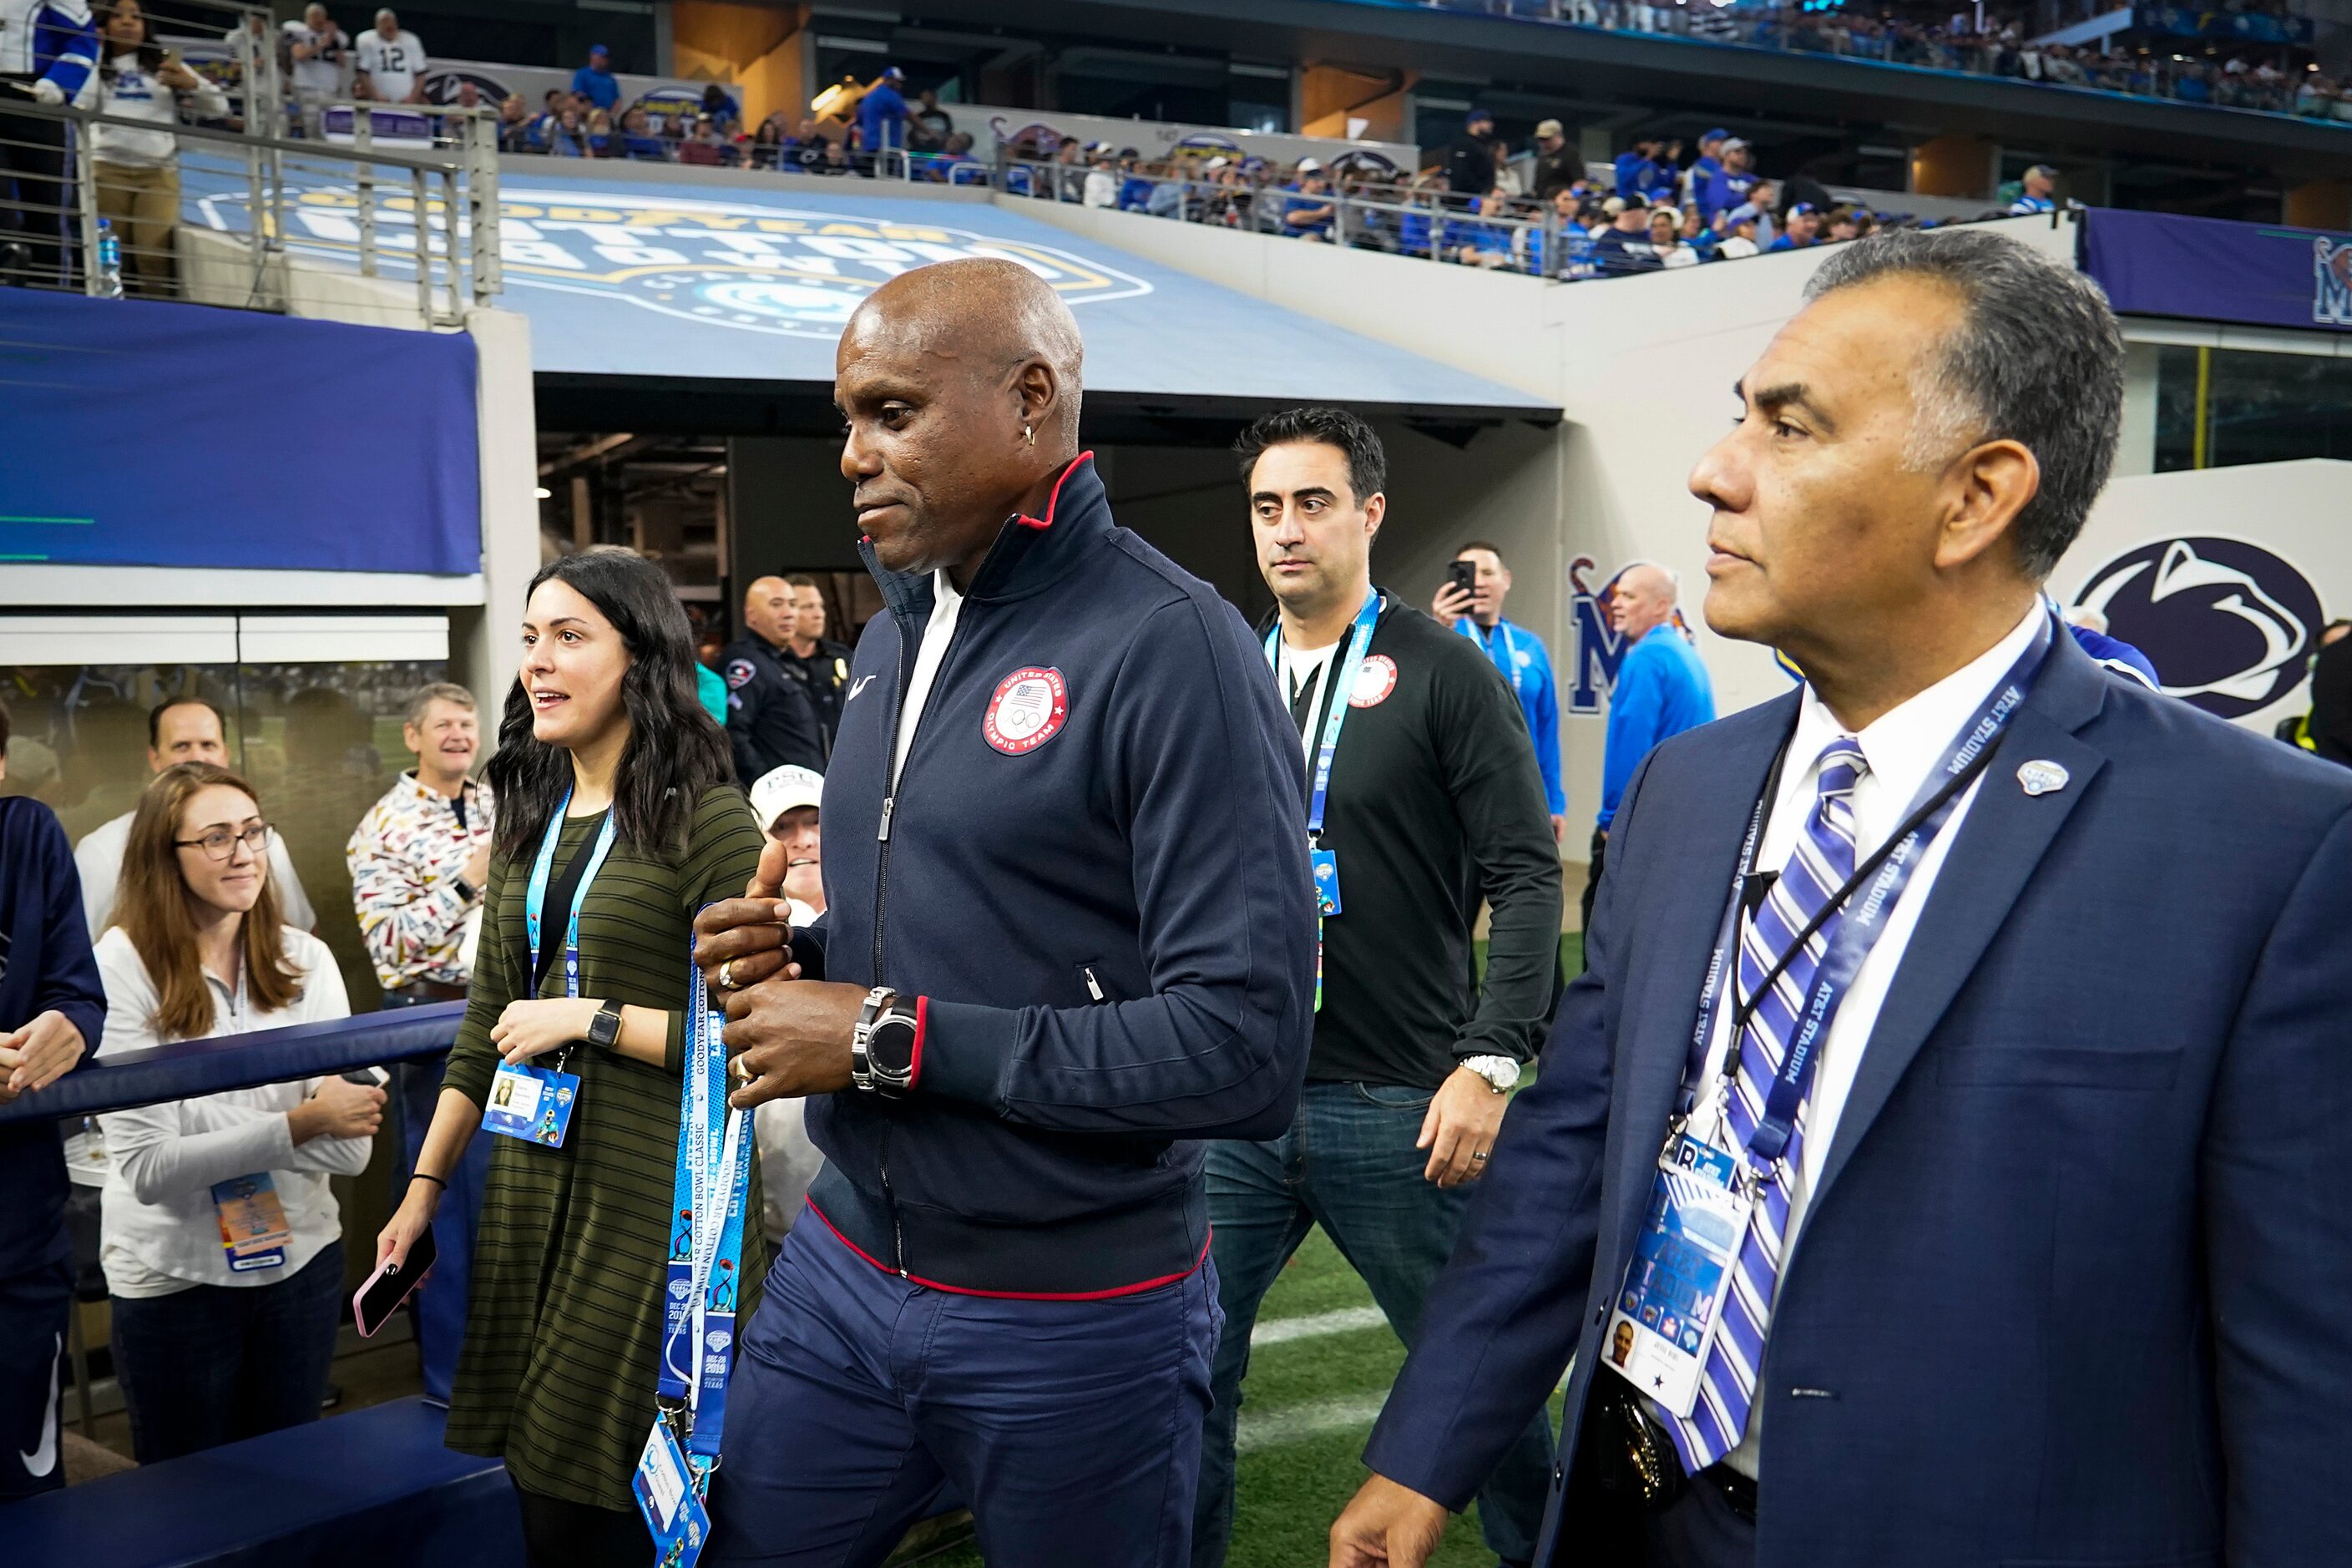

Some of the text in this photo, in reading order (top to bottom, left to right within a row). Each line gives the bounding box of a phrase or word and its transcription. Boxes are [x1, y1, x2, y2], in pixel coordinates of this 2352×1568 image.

[381, 48, 405, 72] 12
[498, 240, 888, 276] BOW
[1004, 671, 1062, 697] UNITED STATES
[988, 712, 1055, 750] OLYMPIC TEAM
[1947, 685, 2021, 775] AT&T STADIUM
[1855, 862, 1900, 926] STADIUM
[1693, 948, 1724, 1045] AT&T STADIUM
[696, 969, 706, 1075] GOODYEAR COTTON
[1785, 980, 1834, 1085] AT&T STADIUM
[695, 1123, 705, 1166] CLASSIC
[739, 1109, 751, 1145] BOW
[695, 1170, 704, 1201] BOWL
[715, 1161, 732, 1221] GOODYEAR
[694, 1203, 704, 1246] COTTON
[669, 1310, 684, 1320] 201
[705, 1363, 726, 1374] 2019
